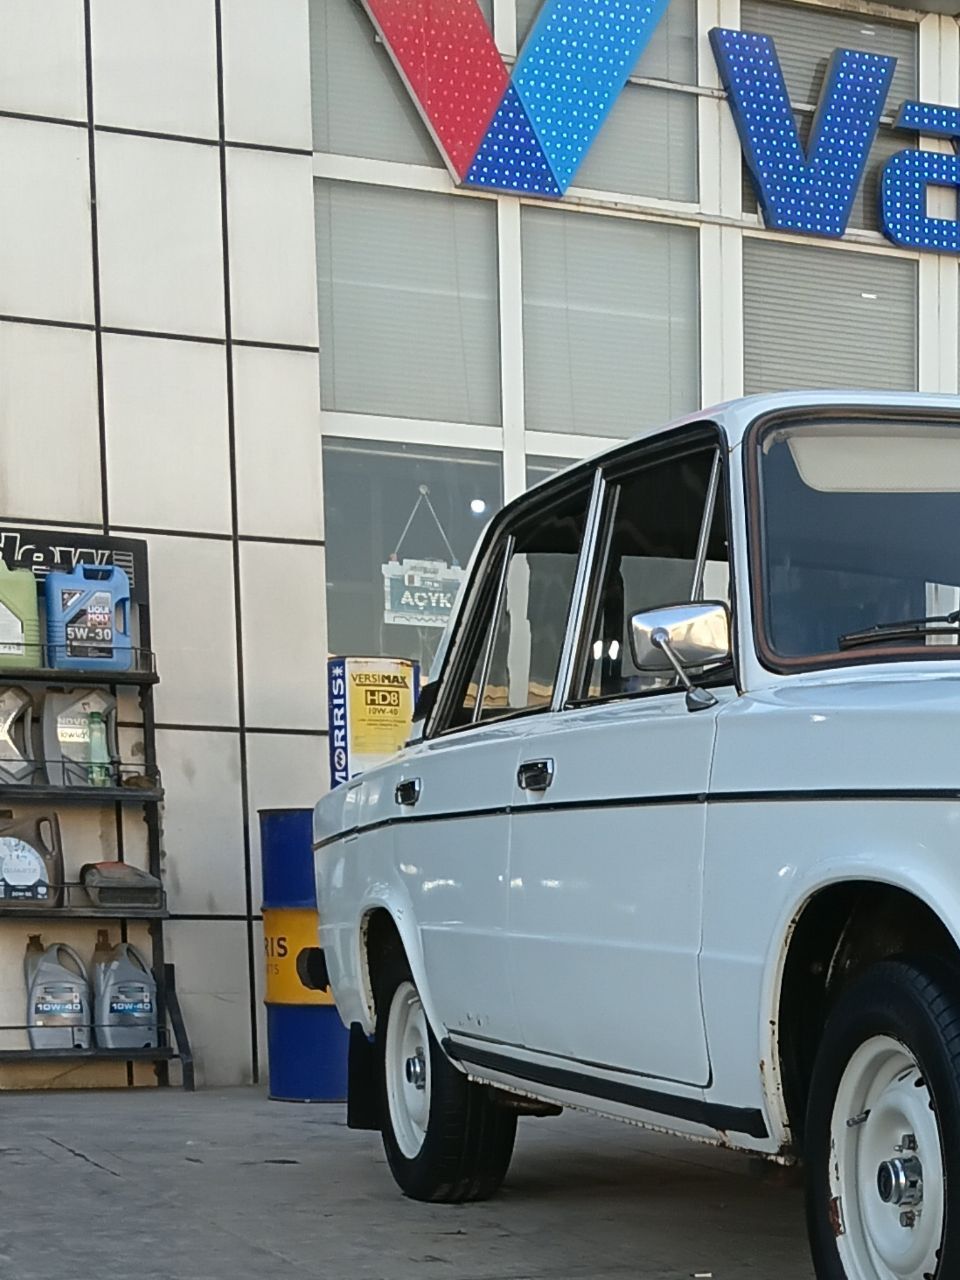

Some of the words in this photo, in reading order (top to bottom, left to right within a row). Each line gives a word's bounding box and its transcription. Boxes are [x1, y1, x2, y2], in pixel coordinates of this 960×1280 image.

[401, 590, 452, 609] AÇYK
[67, 627, 112, 640] 5W-30
[351, 673, 407, 684] VERSIMAX
[366, 691, 399, 705] HD8
[368, 707, 399, 716] 10W-40
[37, 1003, 81, 1011] 10W-40
